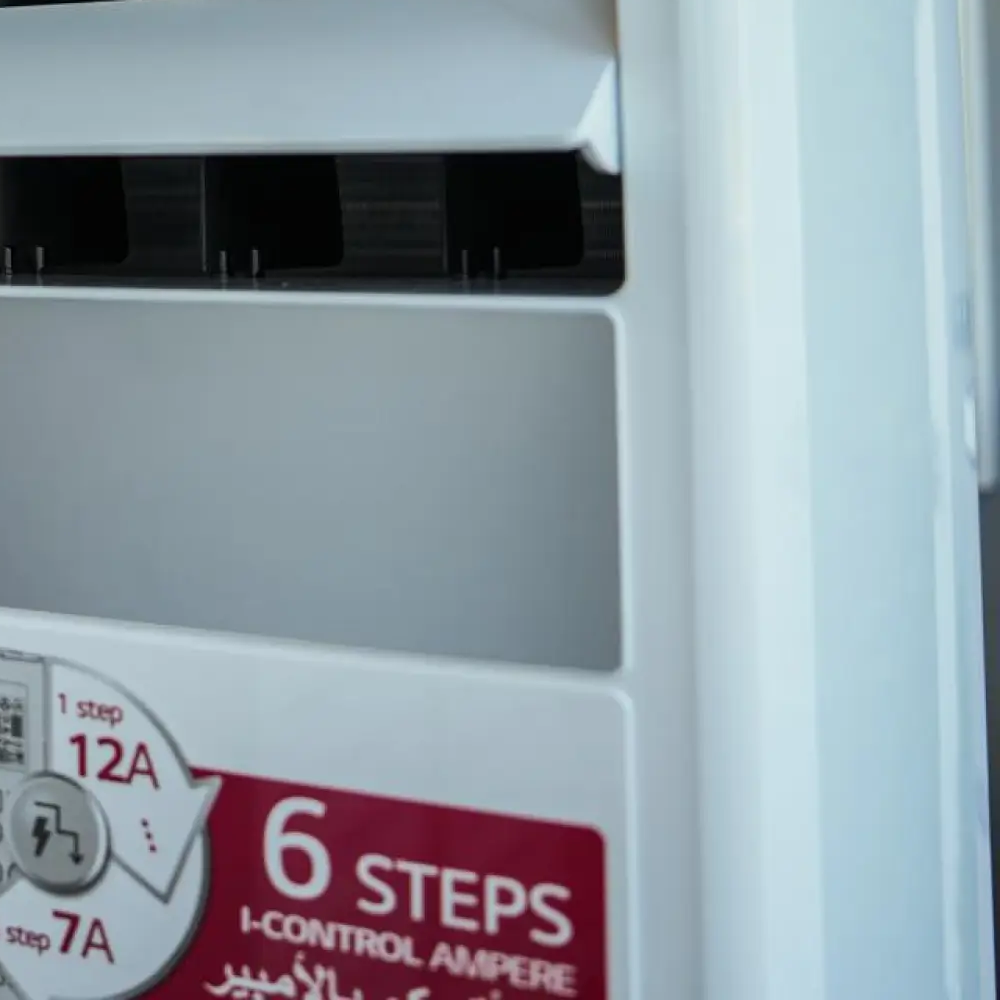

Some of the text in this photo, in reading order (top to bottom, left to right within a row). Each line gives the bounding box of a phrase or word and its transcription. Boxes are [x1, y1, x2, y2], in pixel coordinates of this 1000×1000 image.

[58, 692, 124, 728] 1 step
[69, 733, 159, 790] 12A
[262, 795, 574, 947] 6 STEPS
[6, 926, 51, 958] step
[52, 908, 115, 964] 7A
[240, 904, 578, 998] I-CONTROL AMPERE
